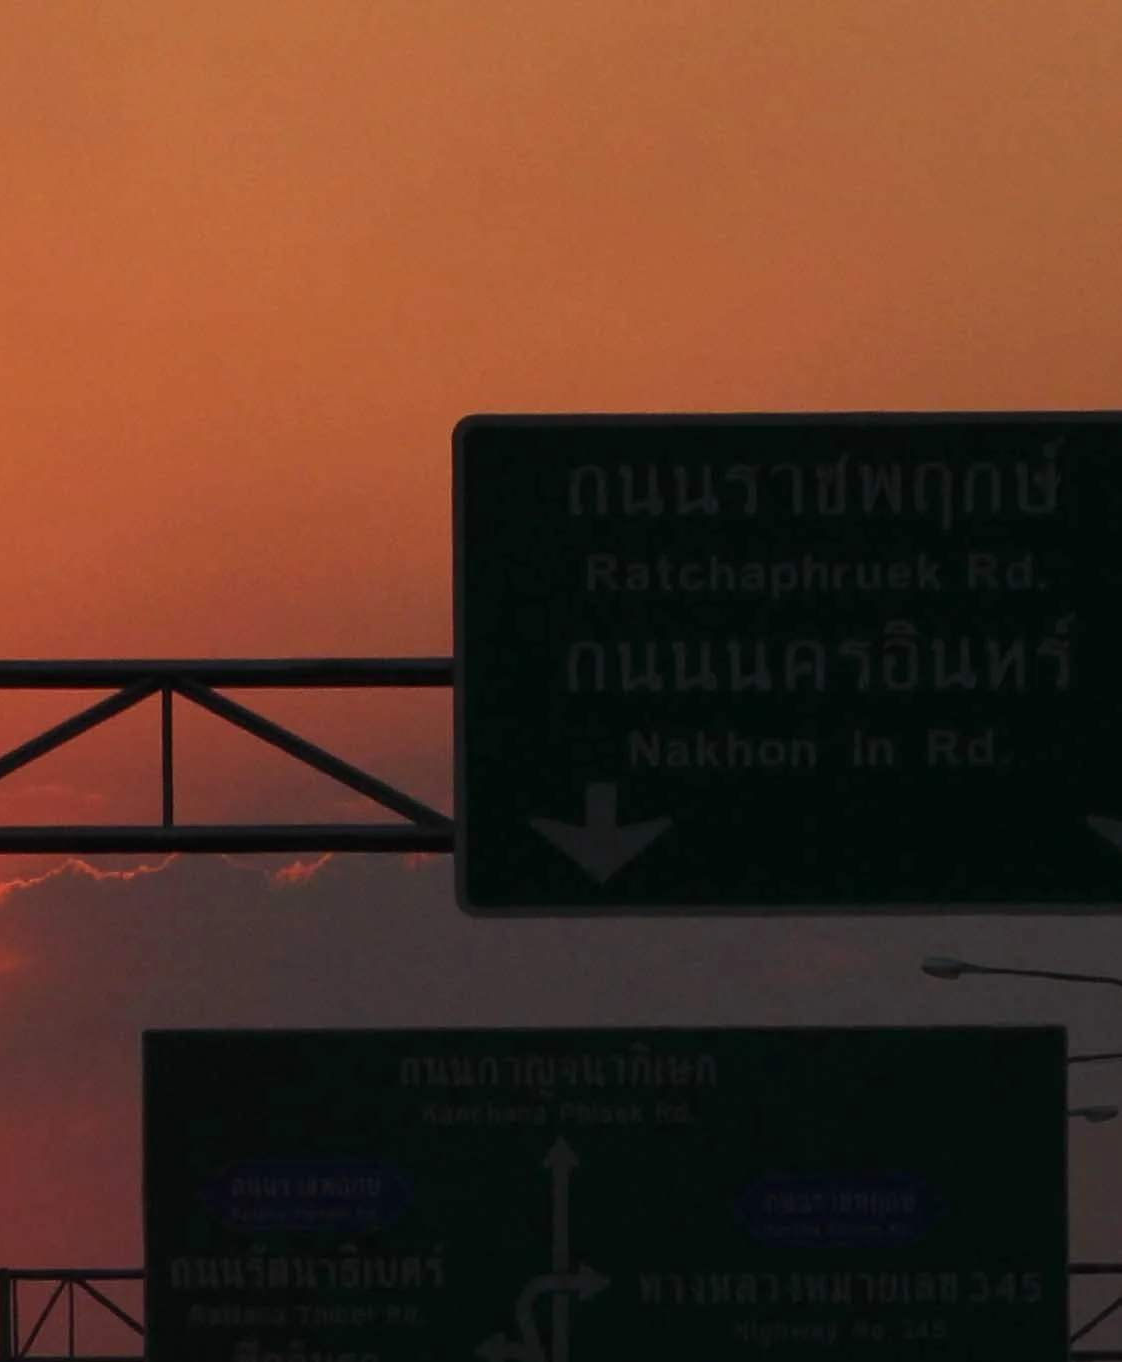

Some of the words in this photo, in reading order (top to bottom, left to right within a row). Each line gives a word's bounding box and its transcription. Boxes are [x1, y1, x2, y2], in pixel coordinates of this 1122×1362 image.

[567, 433, 1068, 531] ถนนราชพฤกษ์
[585, 552, 941, 599] Ratchaphruek
[966, 551, 1047, 592] Rd.
[566, 609, 1078, 693] ถนนนครอินทร์
[629, 729, 818, 769] Nakhon
[853, 731, 893, 767] In
[968, 1270, 1043, 1305] 345
